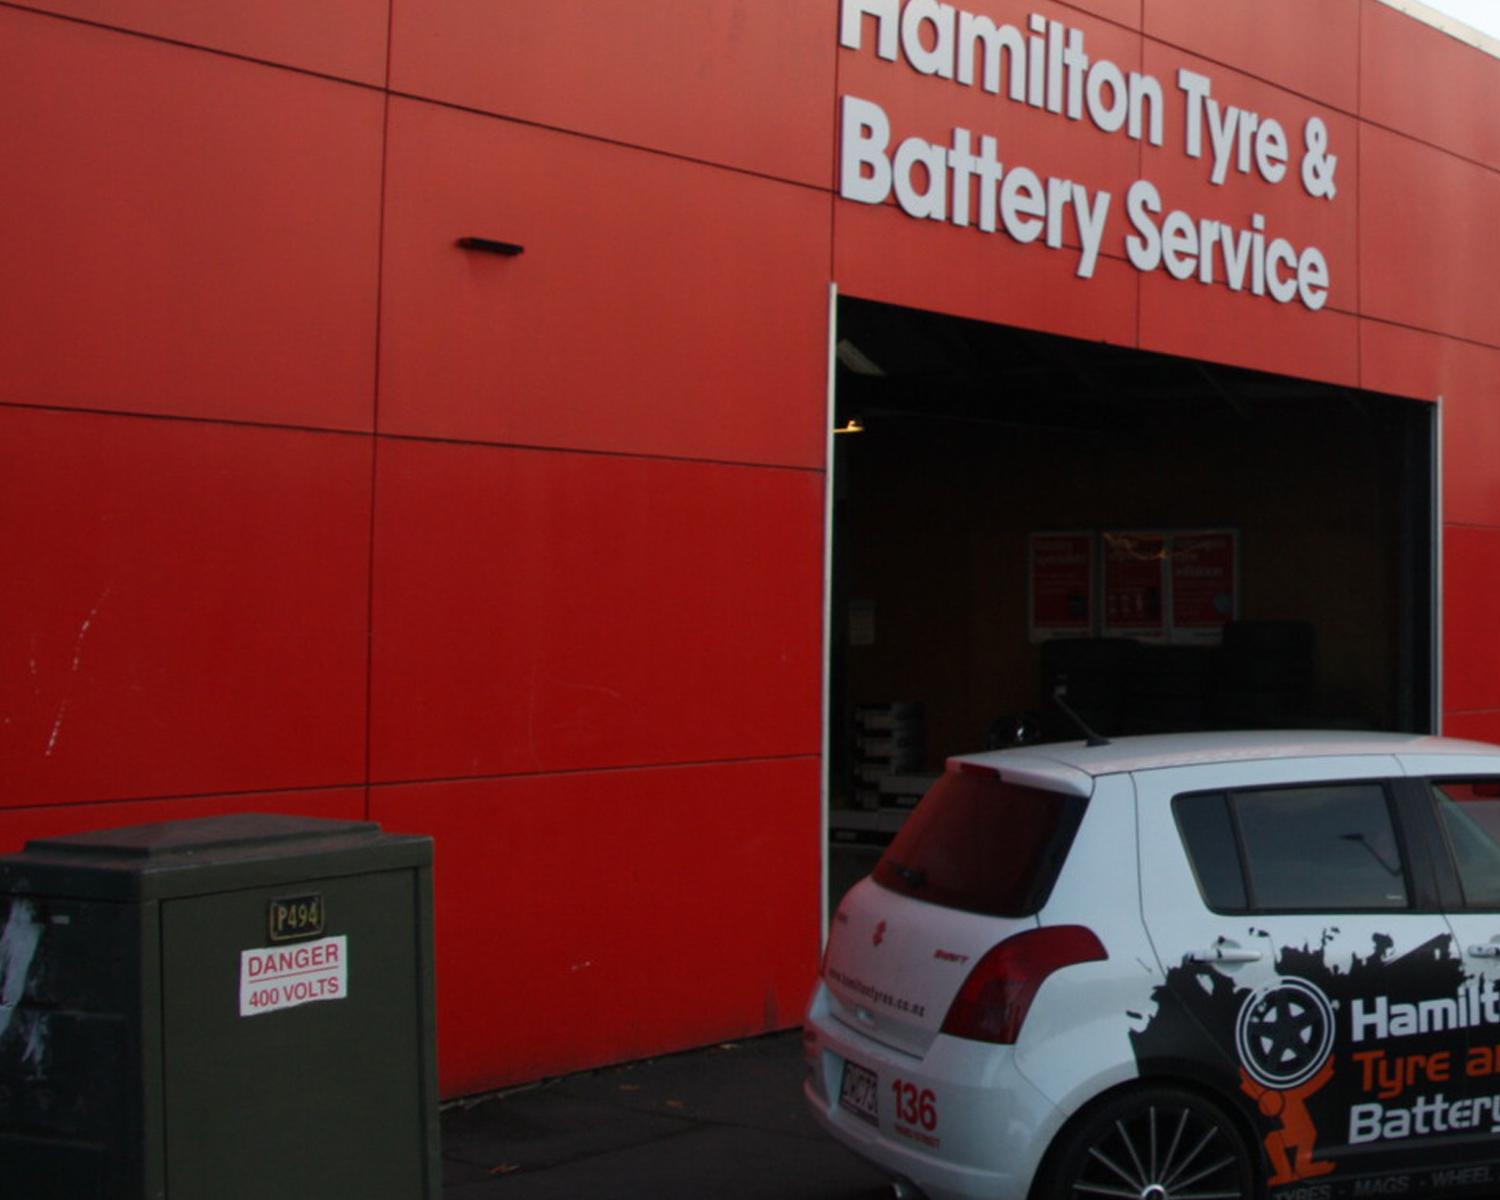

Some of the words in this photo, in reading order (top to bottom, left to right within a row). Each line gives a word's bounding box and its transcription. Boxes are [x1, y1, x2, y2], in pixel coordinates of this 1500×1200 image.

[840, 0, 1164, 147] Hamilton
[1179, 69, 1288, 184] Tyre
[1302, 117, 1337, 200] &
[840, 94, 1111, 279] Battery
[1126, 180, 1330, 310] Service
[276, 902, 319, 931] P494
[248, 943, 338, 977] DANGER
[249, 987, 279, 1008] 400
[284, 976, 339, 1001] VOLTS
[1353, 1051, 1451, 1099] Tyre
[892, 1078, 937, 1132] 136
[1354, 1177, 1410, 1197] MAGS
[1432, 1165, 1493, 1189] WHEEL
